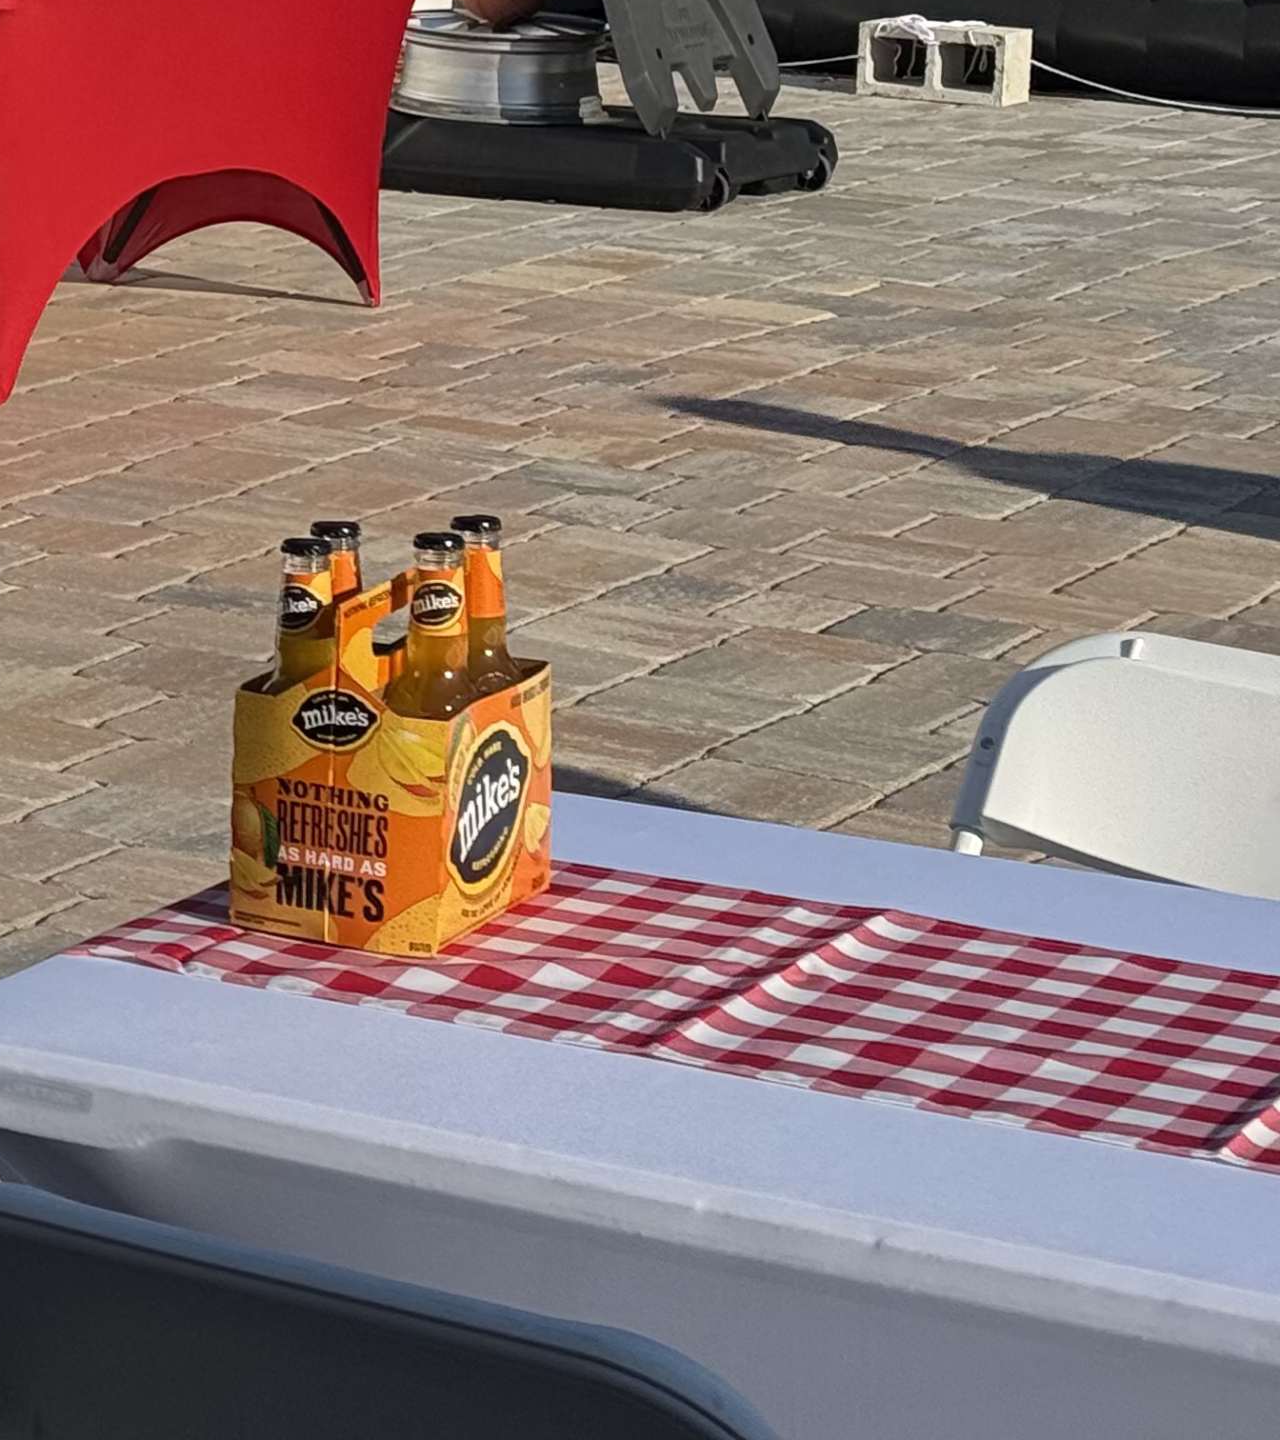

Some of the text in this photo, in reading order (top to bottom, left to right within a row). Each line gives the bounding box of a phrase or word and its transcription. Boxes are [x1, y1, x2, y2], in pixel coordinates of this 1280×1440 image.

[301, 704, 369, 730] mike's
[276, 777, 389, 812] NOTHING
[458, 758, 521, 863] mike's
[277, 799, 388, 858] REFRESHES
[278, 845, 387, 877] AS HARD AS
[276, 861, 384, 923] MIKE'S
